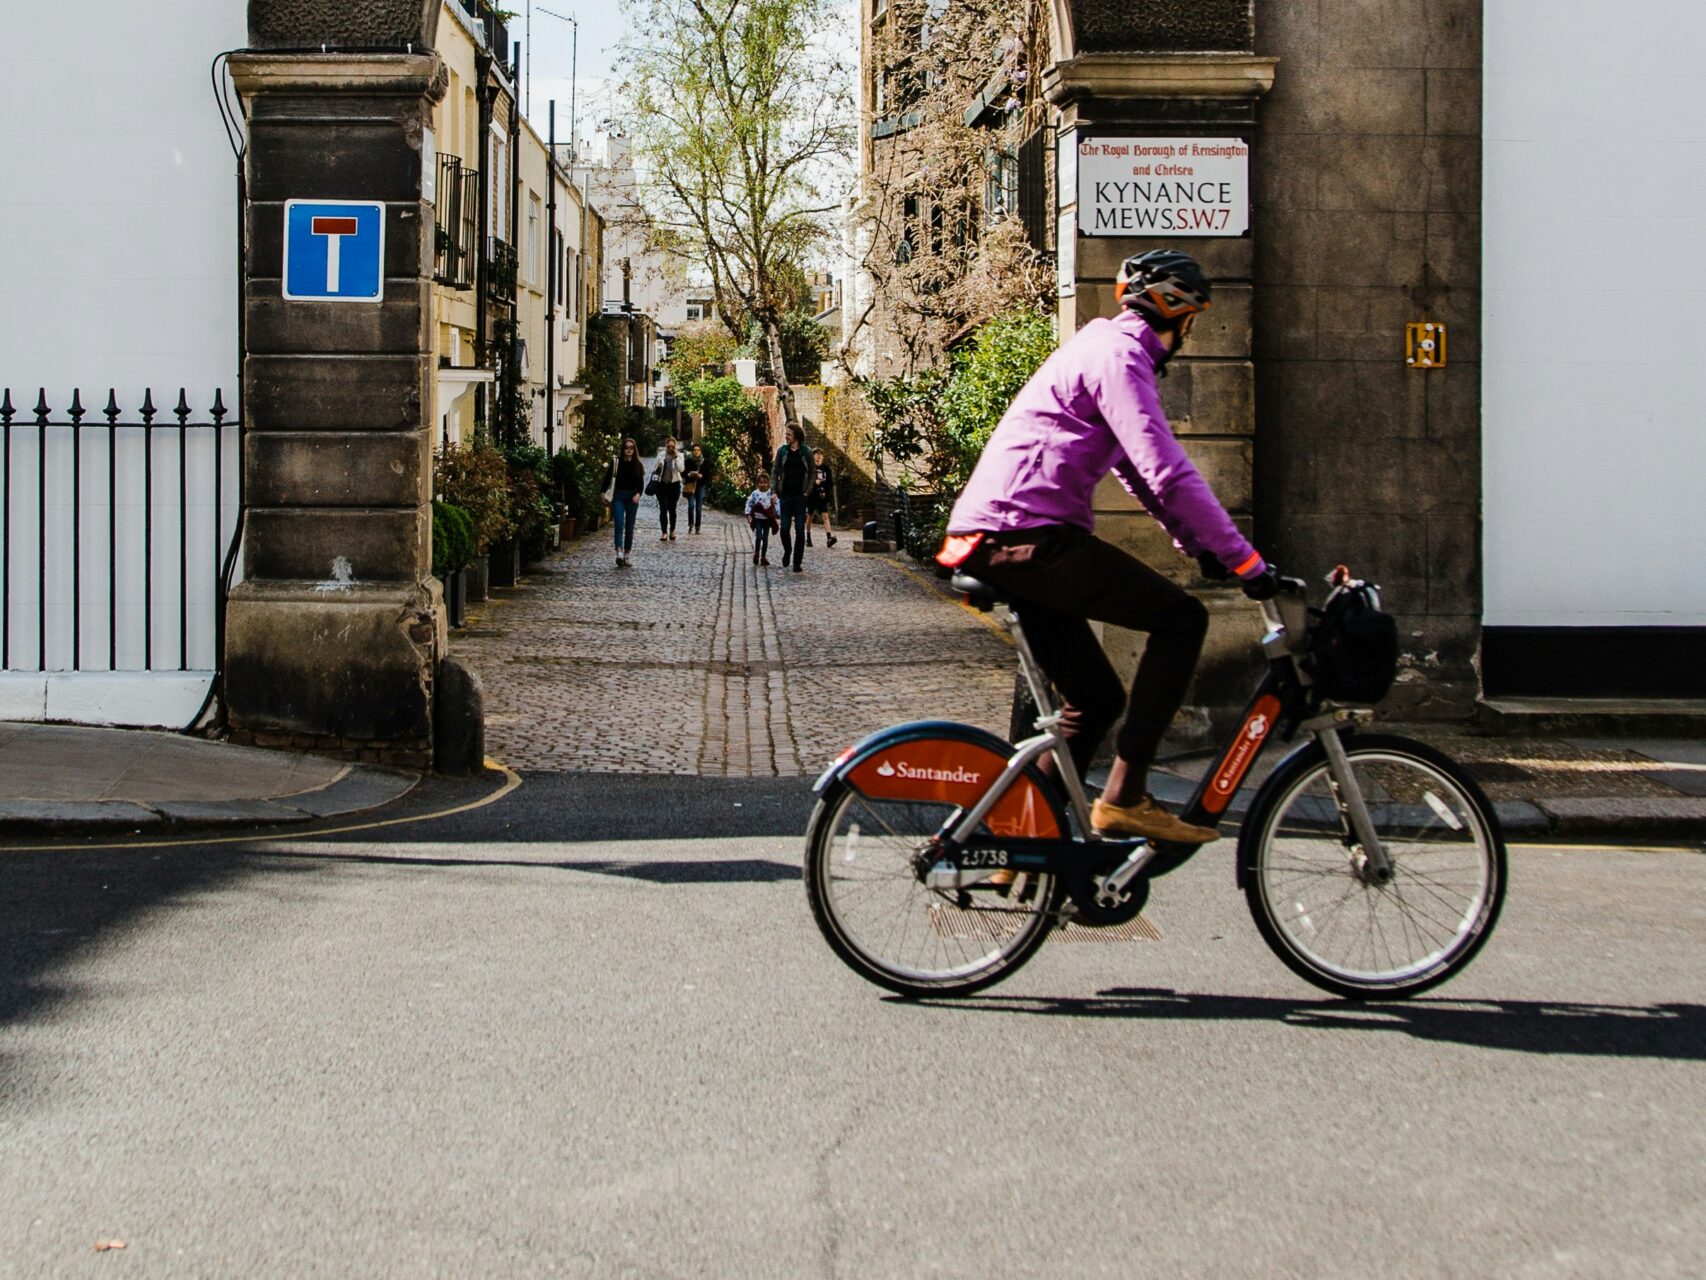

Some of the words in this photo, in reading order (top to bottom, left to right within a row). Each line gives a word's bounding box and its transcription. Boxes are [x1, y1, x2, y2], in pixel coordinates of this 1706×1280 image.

[1081, 143, 1099, 156] The
[1102, 144, 1129, 159] Royal
[1134, 144, 1175, 159] Borough
[1179, 144, 1188, 156] of
[1192, 143, 1248, 159] Kensington
[1133, 165, 1150, 176] and
[1154, 164, 1194, 176] Chelsea
[1095, 182, 1232, 204] KYNANCE
[1223, 740, 1251, 780] Santander
[896, 761, 981, 784] Santander
